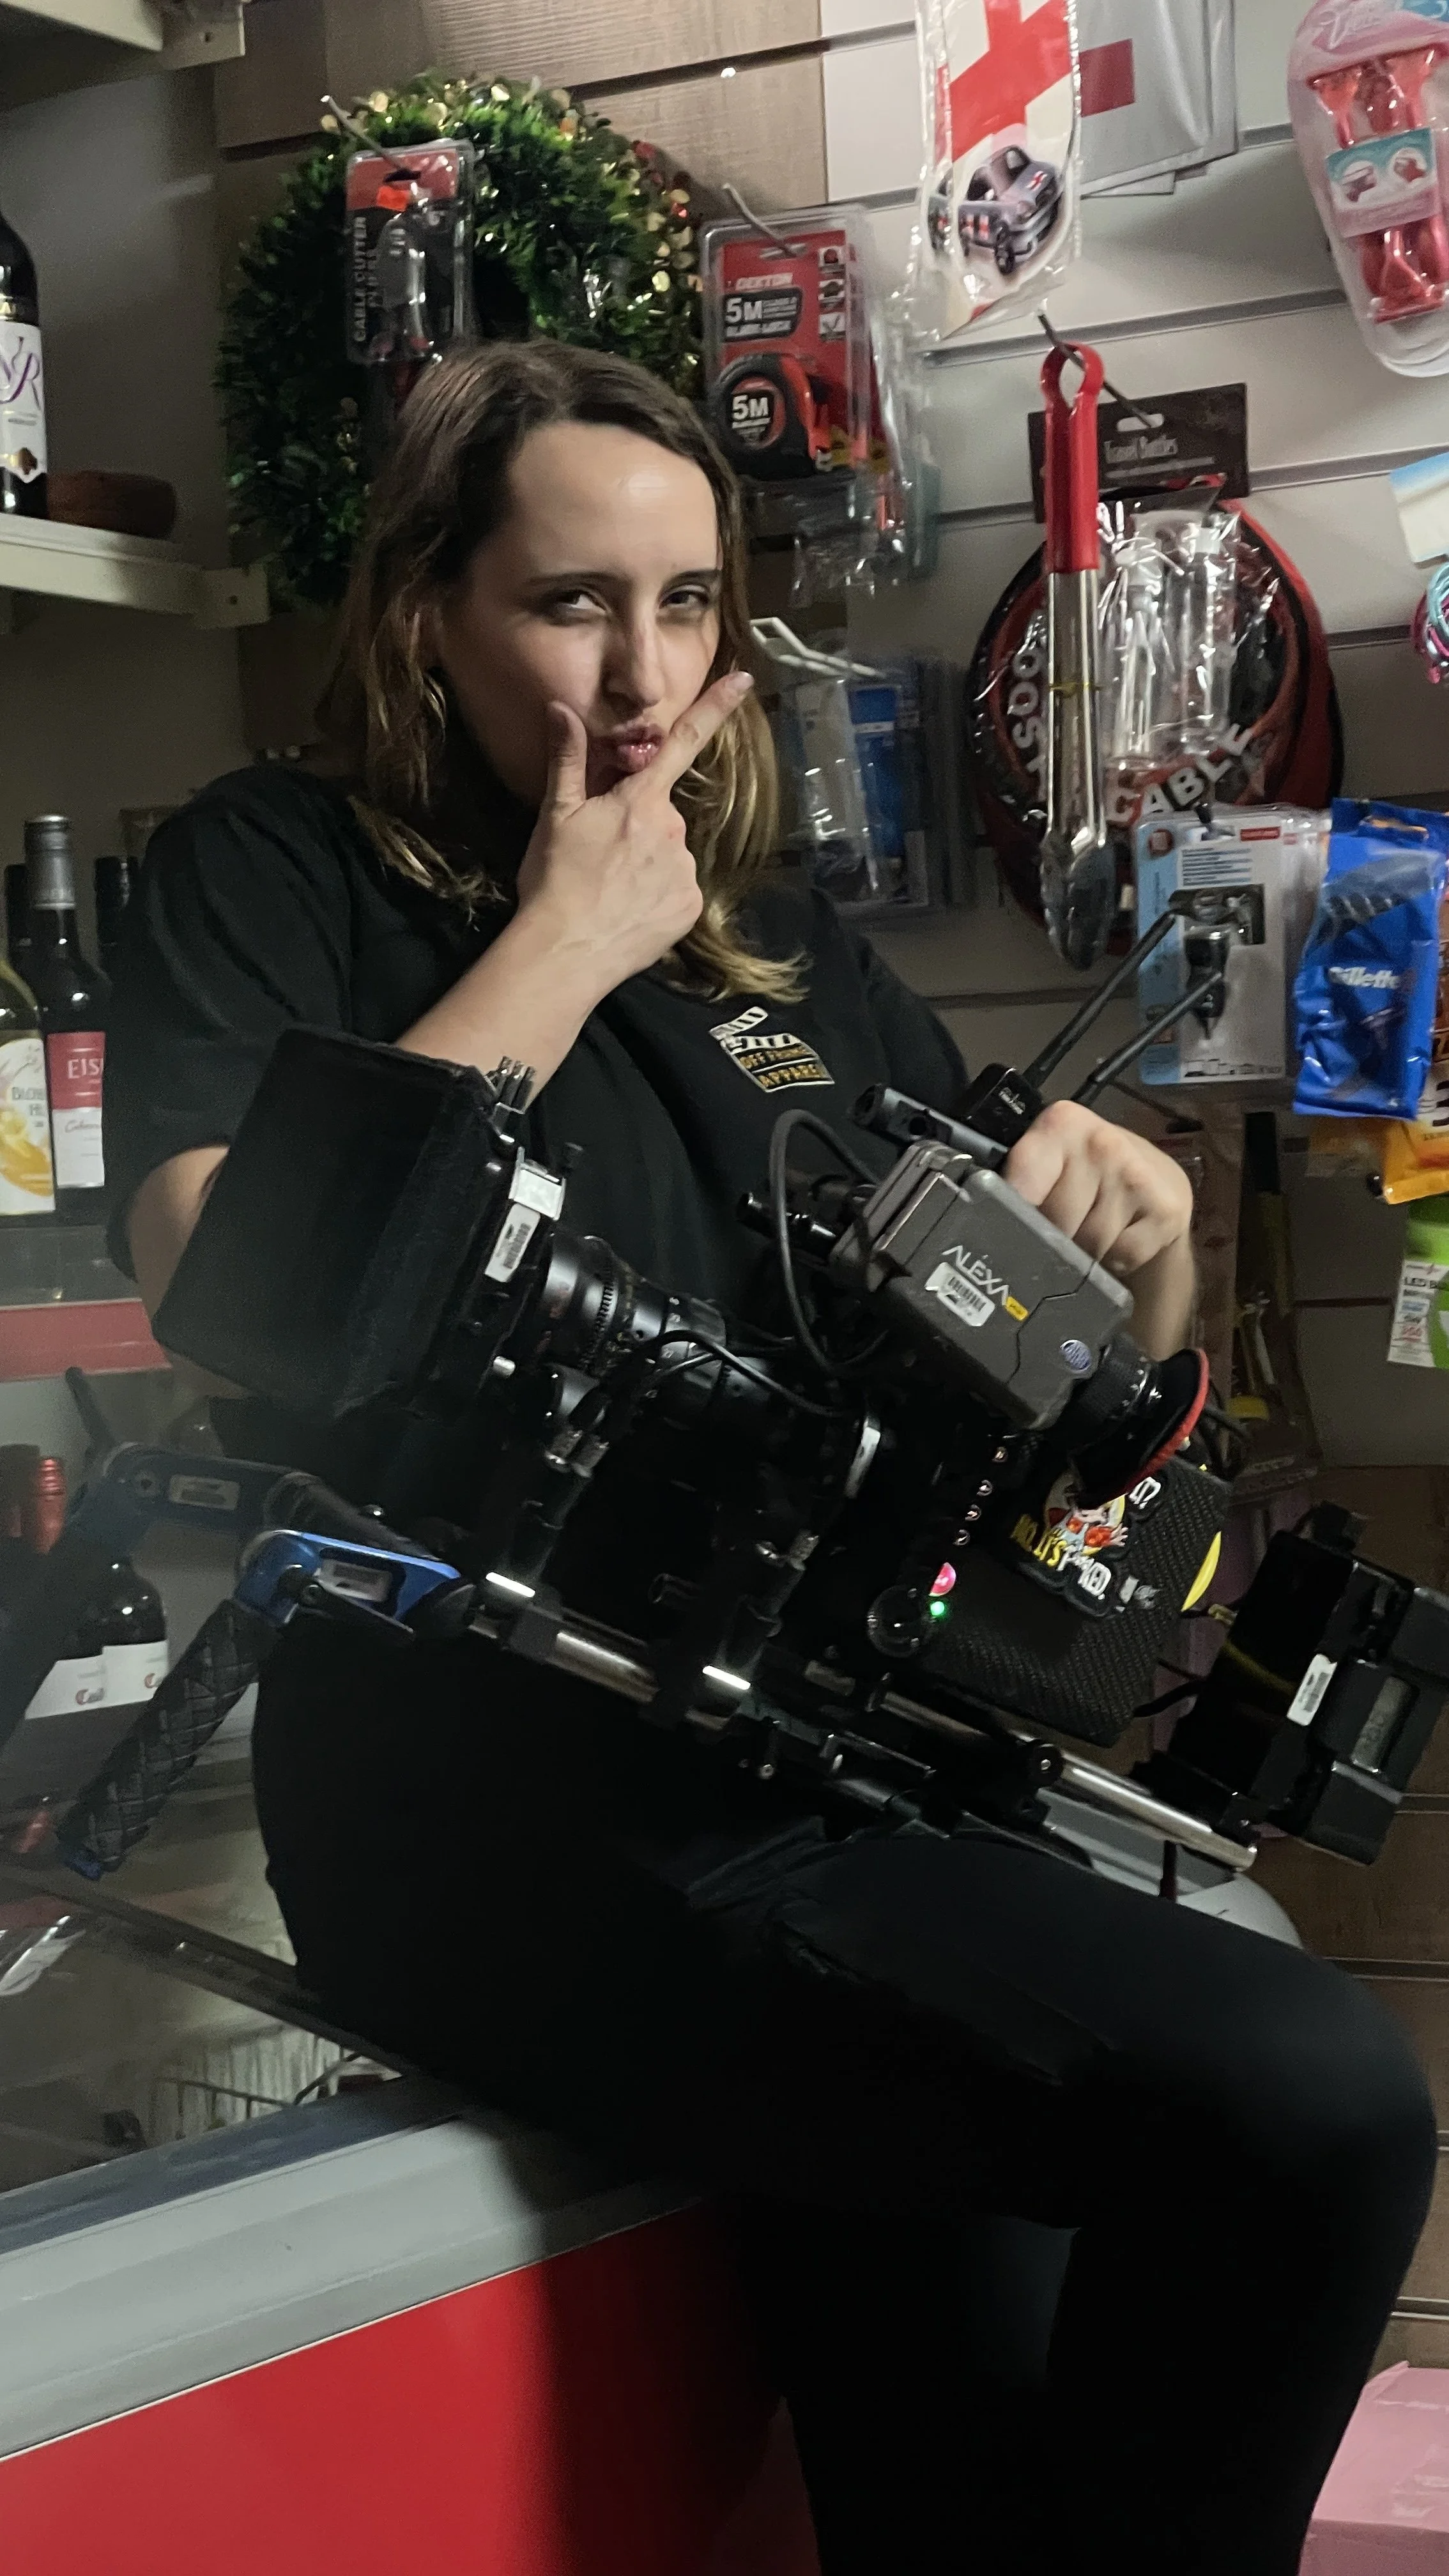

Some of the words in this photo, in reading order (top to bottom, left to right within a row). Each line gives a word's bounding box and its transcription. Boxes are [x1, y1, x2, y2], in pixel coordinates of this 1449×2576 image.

[725, 297, 763, 323] 5M
[732, 394, 769, 420] 5M
[941, 1245, 1009, 1307] ALEXA
